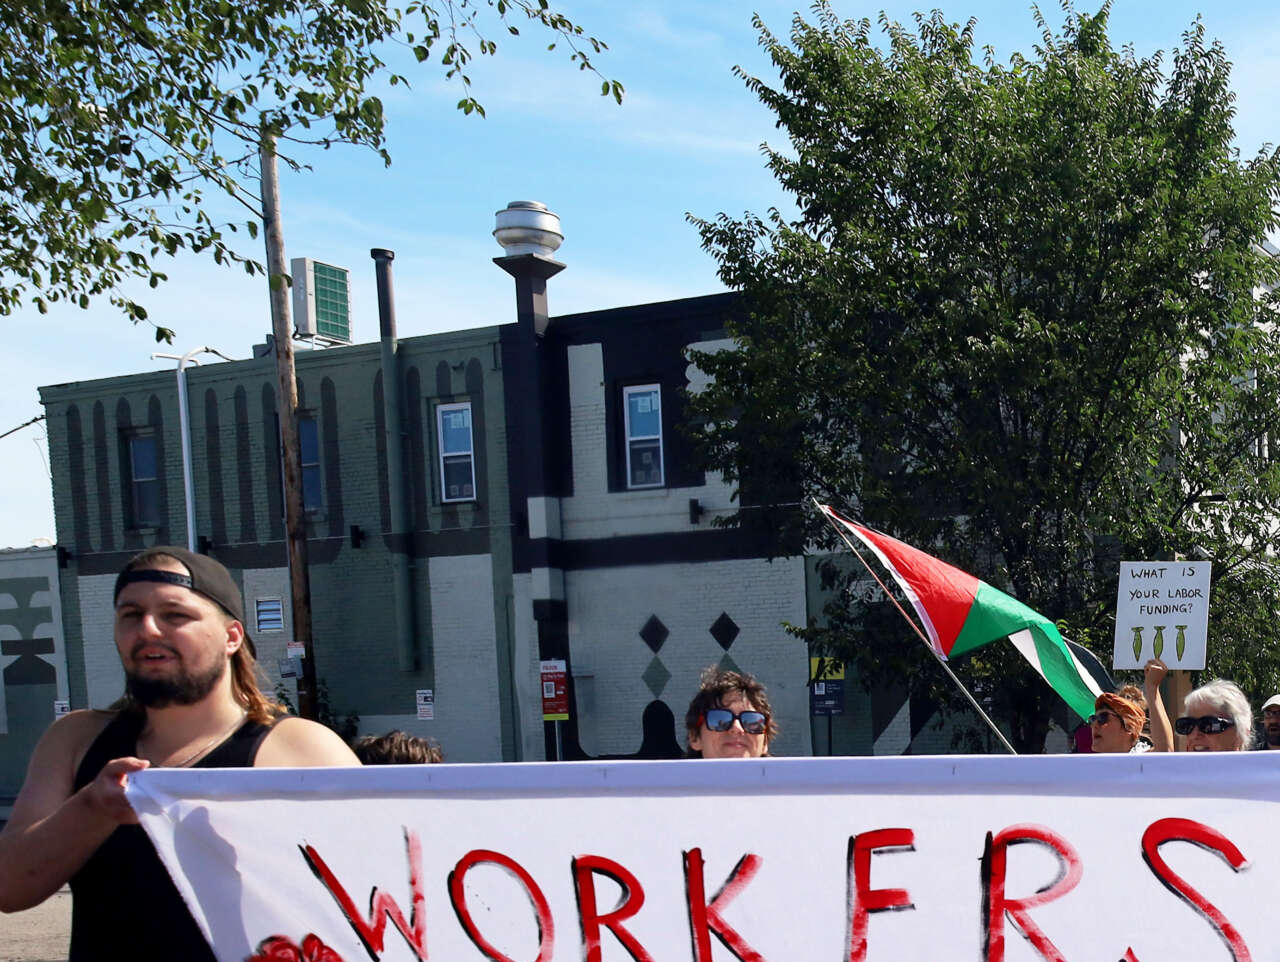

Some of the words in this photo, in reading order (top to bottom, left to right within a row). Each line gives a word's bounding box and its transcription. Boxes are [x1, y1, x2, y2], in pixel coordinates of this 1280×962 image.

[1131, 568, 1167, 579] WHAT
[1182, 567, 1196, 577] IS
[1129, 589, 1160, 600] YOUR
[1168, 588, 1204, 599] LABOR
[1139, 603, 1193, 615] FUNDING?
